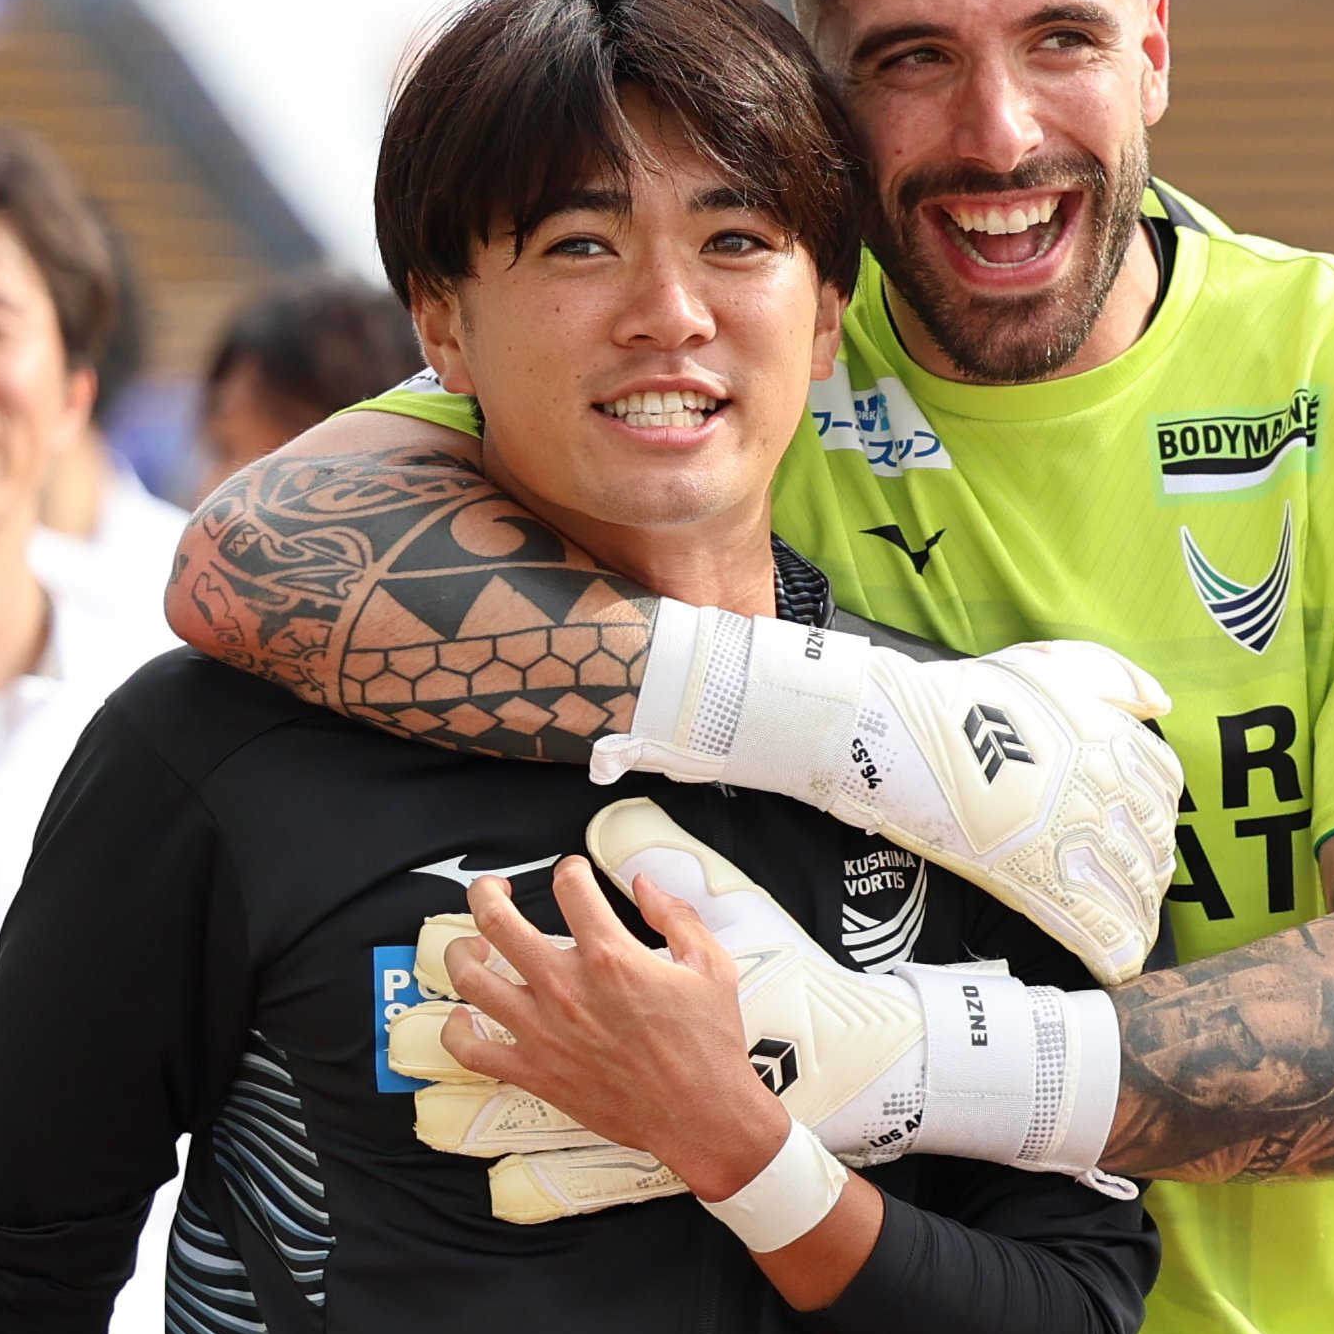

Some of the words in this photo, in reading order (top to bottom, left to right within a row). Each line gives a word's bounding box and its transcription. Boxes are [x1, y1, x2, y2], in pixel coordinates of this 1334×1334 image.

[843, 871, 906, 897] VORTIS
[962, 985, 988, 1047] ENZO
[869, 1128, 904, 1147] LOS
